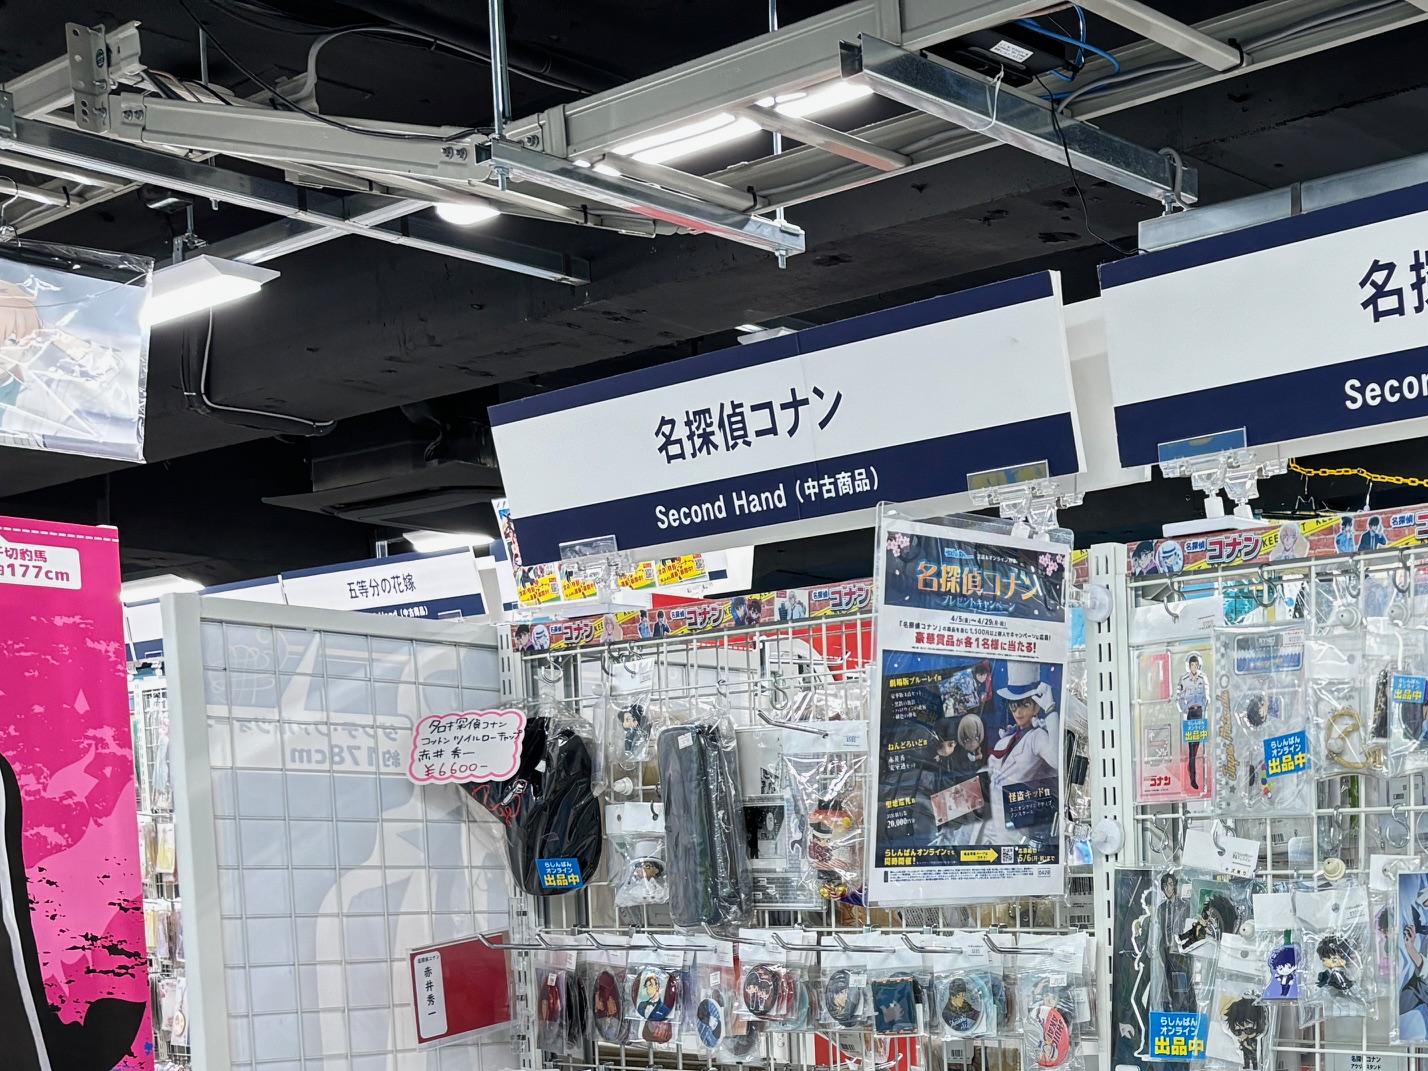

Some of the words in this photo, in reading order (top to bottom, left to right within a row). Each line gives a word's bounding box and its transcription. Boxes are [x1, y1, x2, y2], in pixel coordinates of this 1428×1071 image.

[653, 385, 843, 464] 名探偵コナン
[656, 496, 726, 529] Second
[733, 483, 787, 515] Hand
[795, 466, 880, 506] （中古商品）
[1391, 513, 1414, 528] 名探偵
[1185, 539, 1206, 552] 名探偵
[1206, 533, 1261, 562] コナン
[347, 573, 416, 600] 五等分の花嫁
[916, 561, 1039, 601] 名探偵コナン
[830, 584, 872, 611] コナン
[686, 608, 723, 630] コナン
[563, 621, 595, 643] コナン
[1394, 689, 1422, 701] 出品中
[1185, 730, 1208, 741] 出品中
[1270, 735, 1301, 749] らしんばん
[1271, 744, 1302, 758] オンライン
[1268, 753, 1308, 775] 出品中
[1149, 776, 1171, 787] コナン
[543, 873, 580, 888] 出品中
[423, 966, 437, 1016] 赤井秀一
[1160, 1016, 1198, 1027] らしんばん
[1160, 1025, 1198, 1036] オンライン
[1154, 1036, 1204, 1056] 出品中
